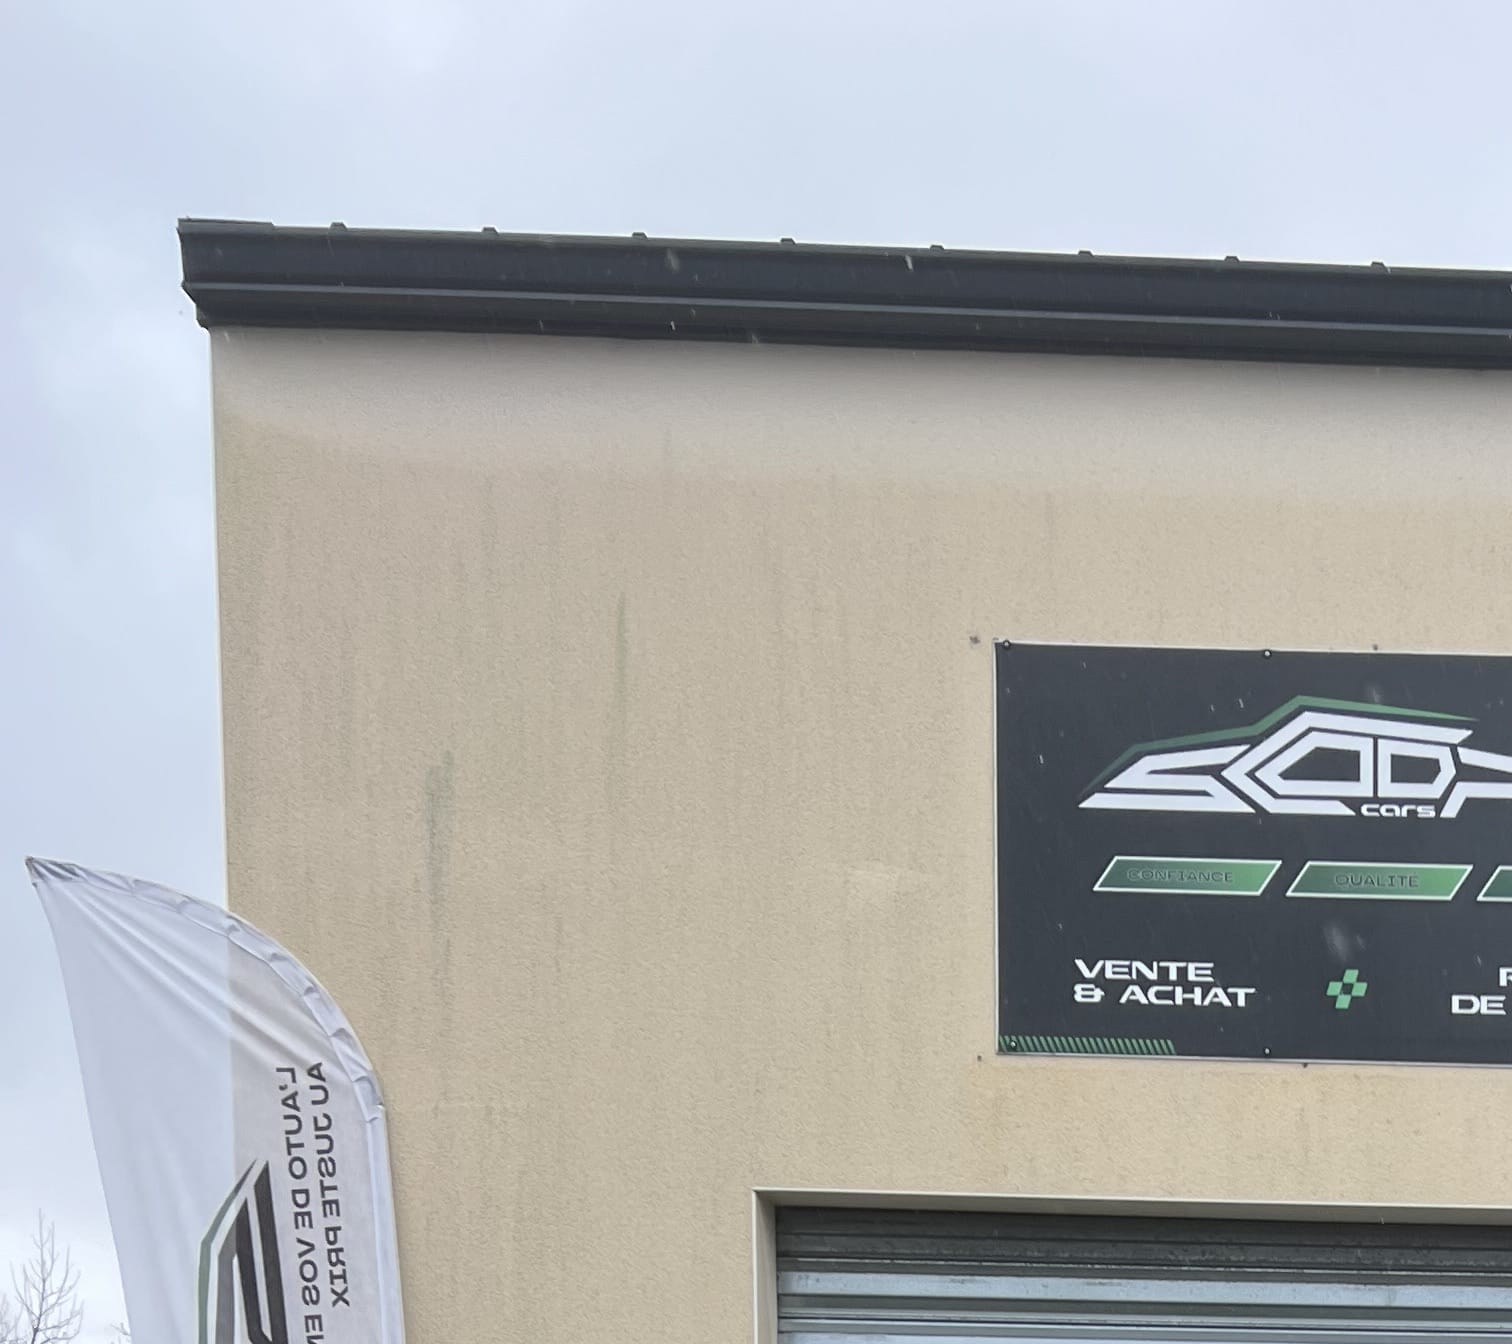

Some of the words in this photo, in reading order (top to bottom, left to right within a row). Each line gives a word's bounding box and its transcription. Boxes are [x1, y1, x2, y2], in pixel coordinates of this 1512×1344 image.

[1360, 803, 1436, 818] cars
[1126, 867, 1234, 883] CONFIANCE
[1074, 958, 1215, 983] VENTE
[1073, 983, 1105, 1004] &
[1118, 984, 1256, 1008] ACHAT
[1450, 993, 1507, 1016] DE
